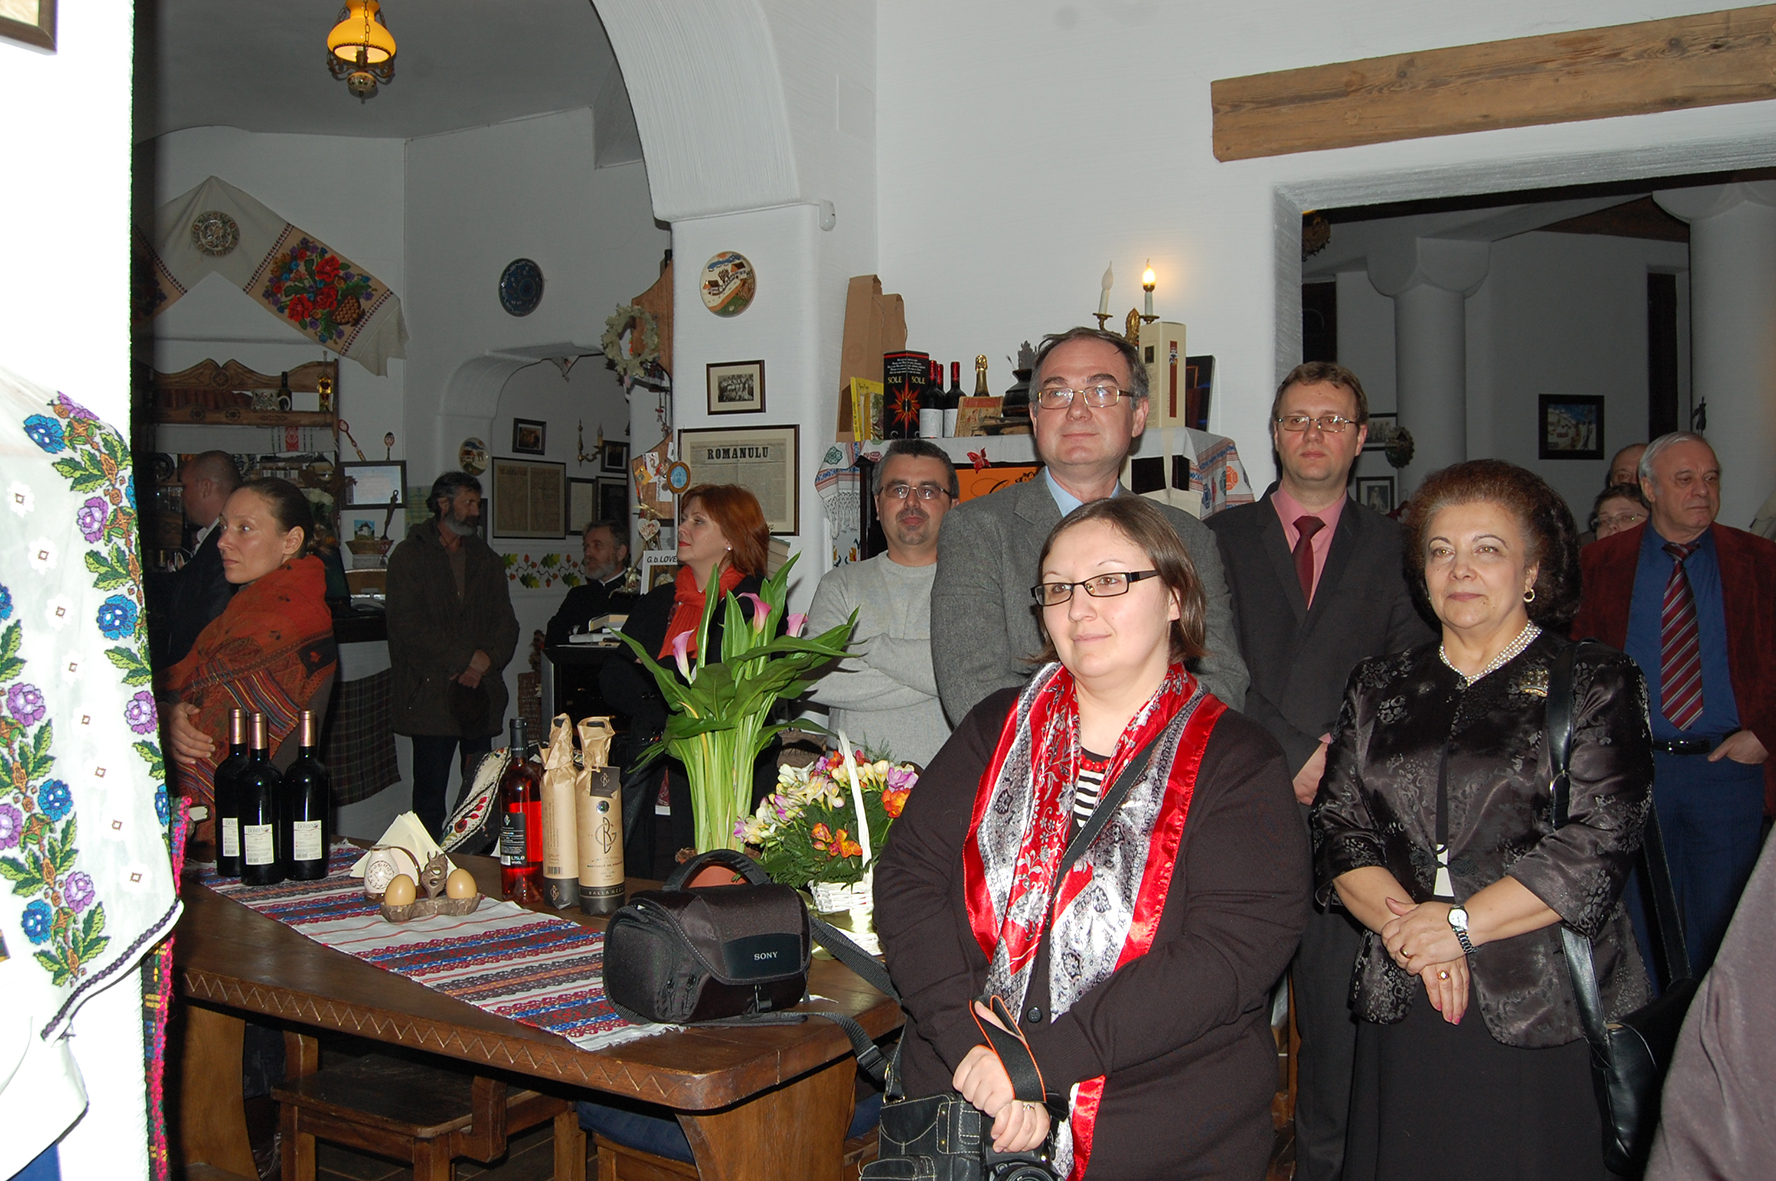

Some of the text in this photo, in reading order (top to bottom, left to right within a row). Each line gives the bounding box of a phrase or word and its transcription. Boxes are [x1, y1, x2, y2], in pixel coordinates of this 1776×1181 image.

[887, 375, 903, 384] SOLE
[911, 375, 926, 385] SOLE
[707, 446, 769, 460] ROMANULU
[753, 951, 779, 961] SONY
